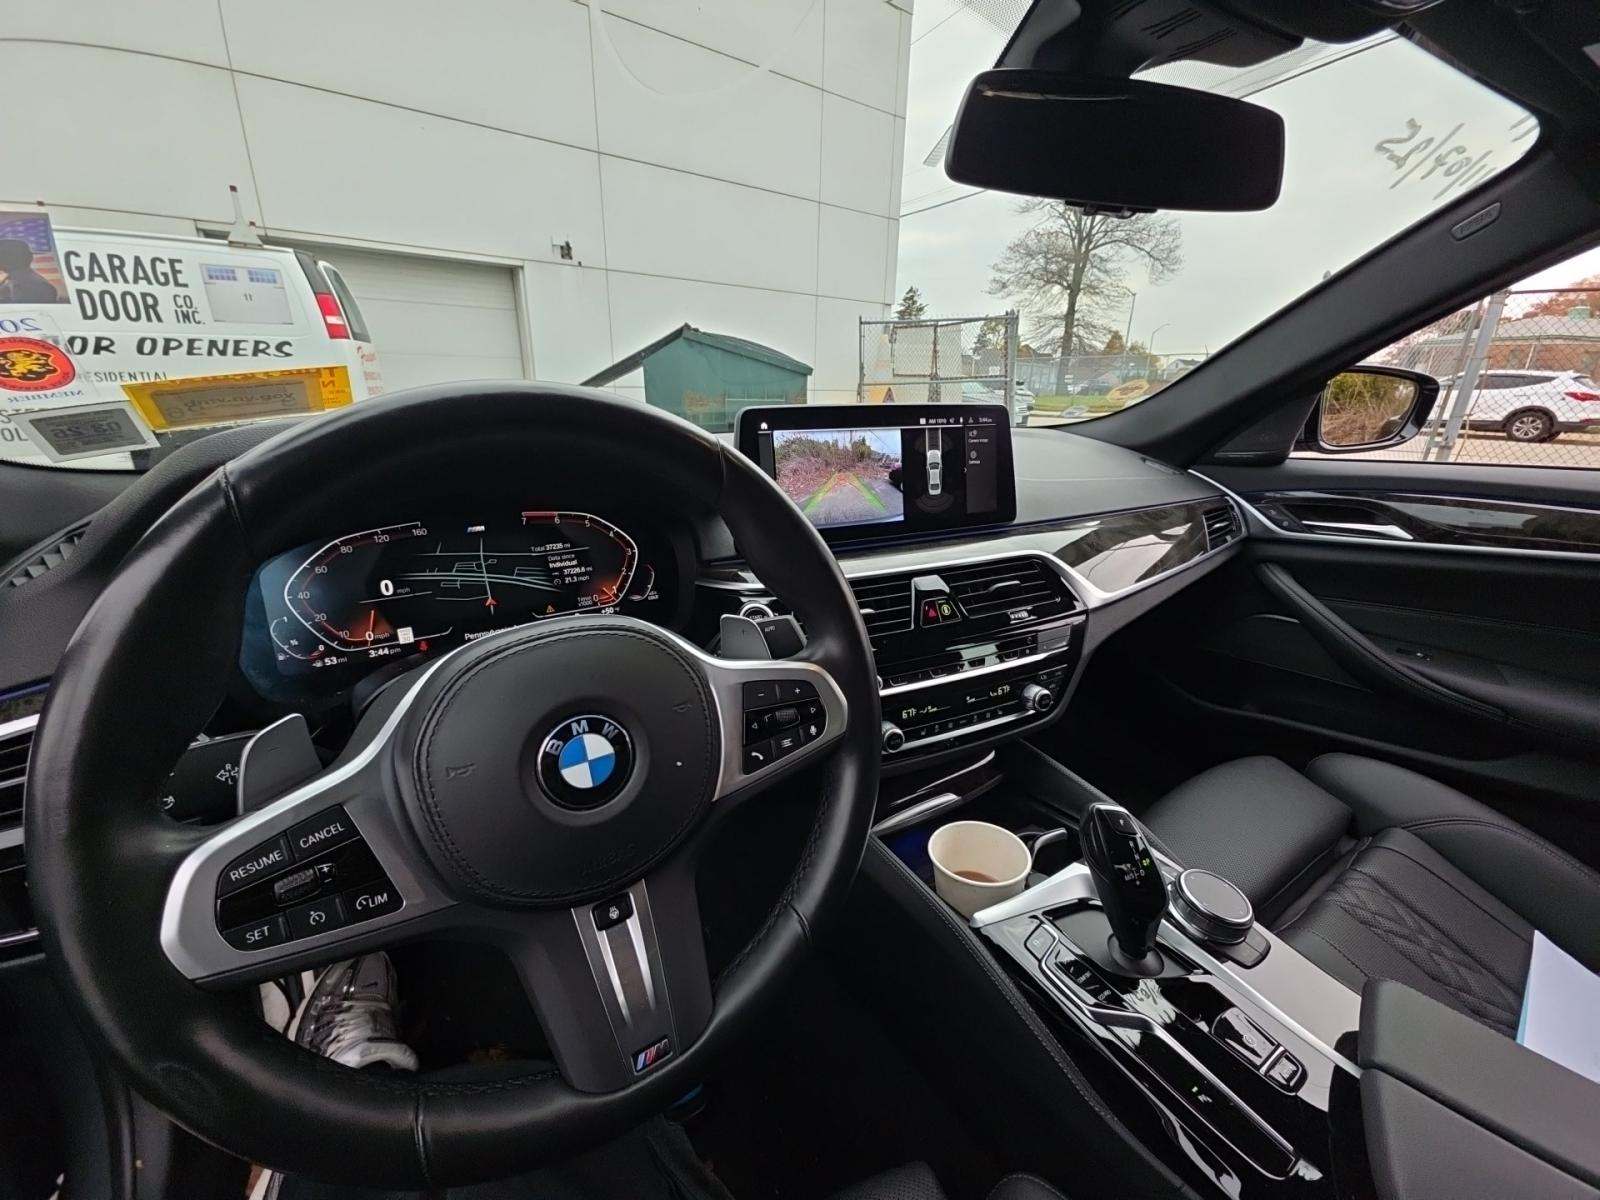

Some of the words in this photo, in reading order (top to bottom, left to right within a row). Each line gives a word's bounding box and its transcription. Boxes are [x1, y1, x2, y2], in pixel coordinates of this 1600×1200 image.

[63, 250, 189, 288] GARAGE
[75, 288, 164, 323] DOOR
[173, 294, 198, 310] CO.
[174, 309, 206, 325] INC.
[136, 337, 294, 358] OPENERS
[521, 518, 527, 526] 7
[554, 516, 561, 524] 6
[584, 519, 591, 528] 5
[412, 528, 428, 536] 160
[373, 534, 390, 543] 120
[340, 545, 353, 554] 80
[626, 548, 632, 556] 3
[548, 559, 578, 569] Individual
[314, 565, 328, 574] 60
[380, 579, 394, 596] 0
[297, 590, 311, 600] 40
[592, 594, 599, 602] 0
[314, 613, 327, 622] 20
[338, 630, 350, 639] 10
[365, 631, 374, 641] 0
[374, 631, 390, 640] mph
[368, 647, 390, 658] 3:44
[390, 648, 402, 656] pm
[324, 656, 338, 666] 53
[545, 719, 619, 756] BMW
[224, 763, 232, 771] R
[299, 822, 345, 849] CANCEL
[229, 850, 284, 882] RESUME
[368, 892, 388, 908] LIM
[246, 926, 271, 944] SET
